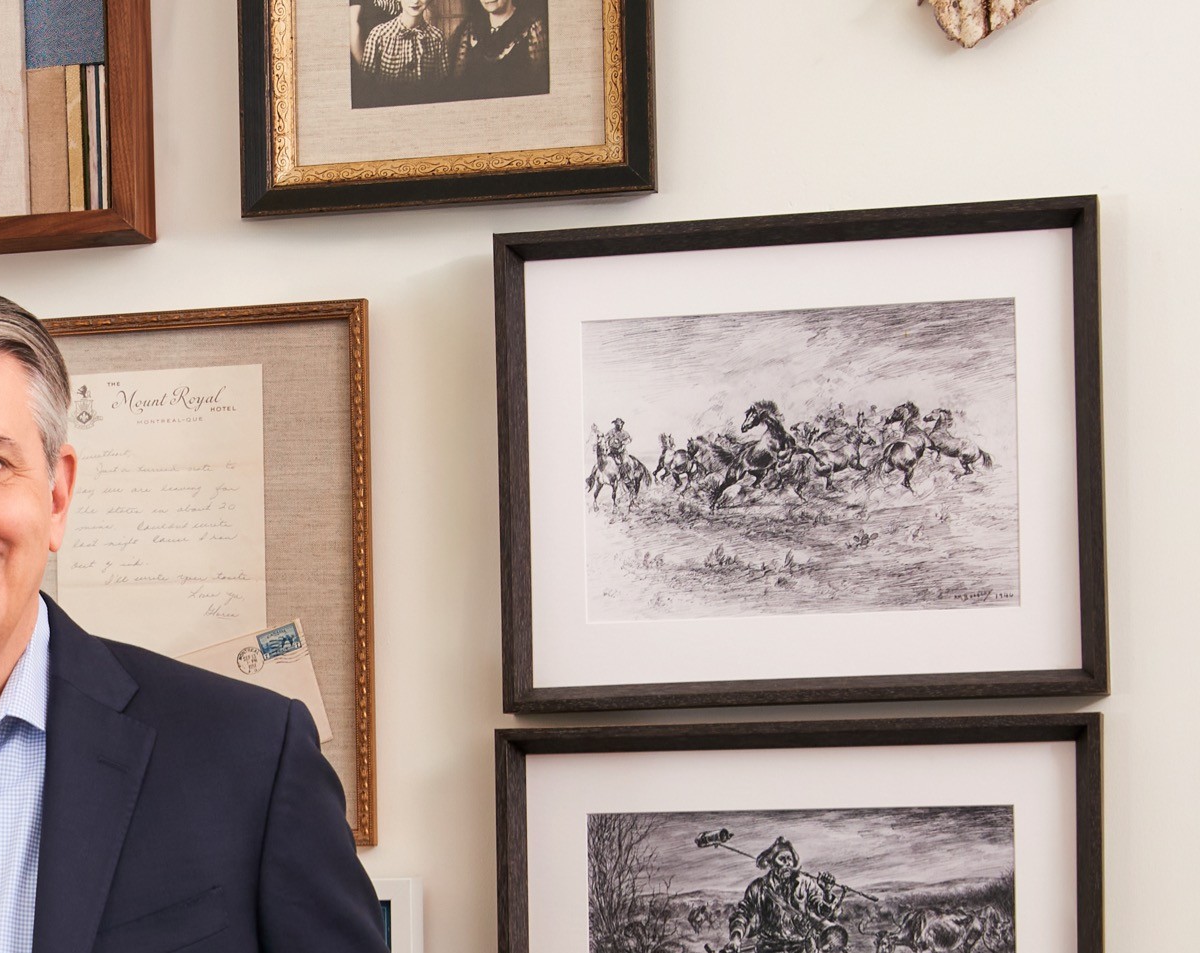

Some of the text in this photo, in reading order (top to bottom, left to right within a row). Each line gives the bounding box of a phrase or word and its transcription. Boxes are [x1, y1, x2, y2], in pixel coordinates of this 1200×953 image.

[111, 386, 227, 416] Mount Royal
[225, 460, 237, 470] to
[76, 506, 97, 515] the
[151, 507, 169, 515] in
[176, 502, 213, 514] about
[218, 502, 236, 511] 20
[72, 538, 99, 549] last
[104, 535, 140, 551] night
[70, 559, 97, 570] out
